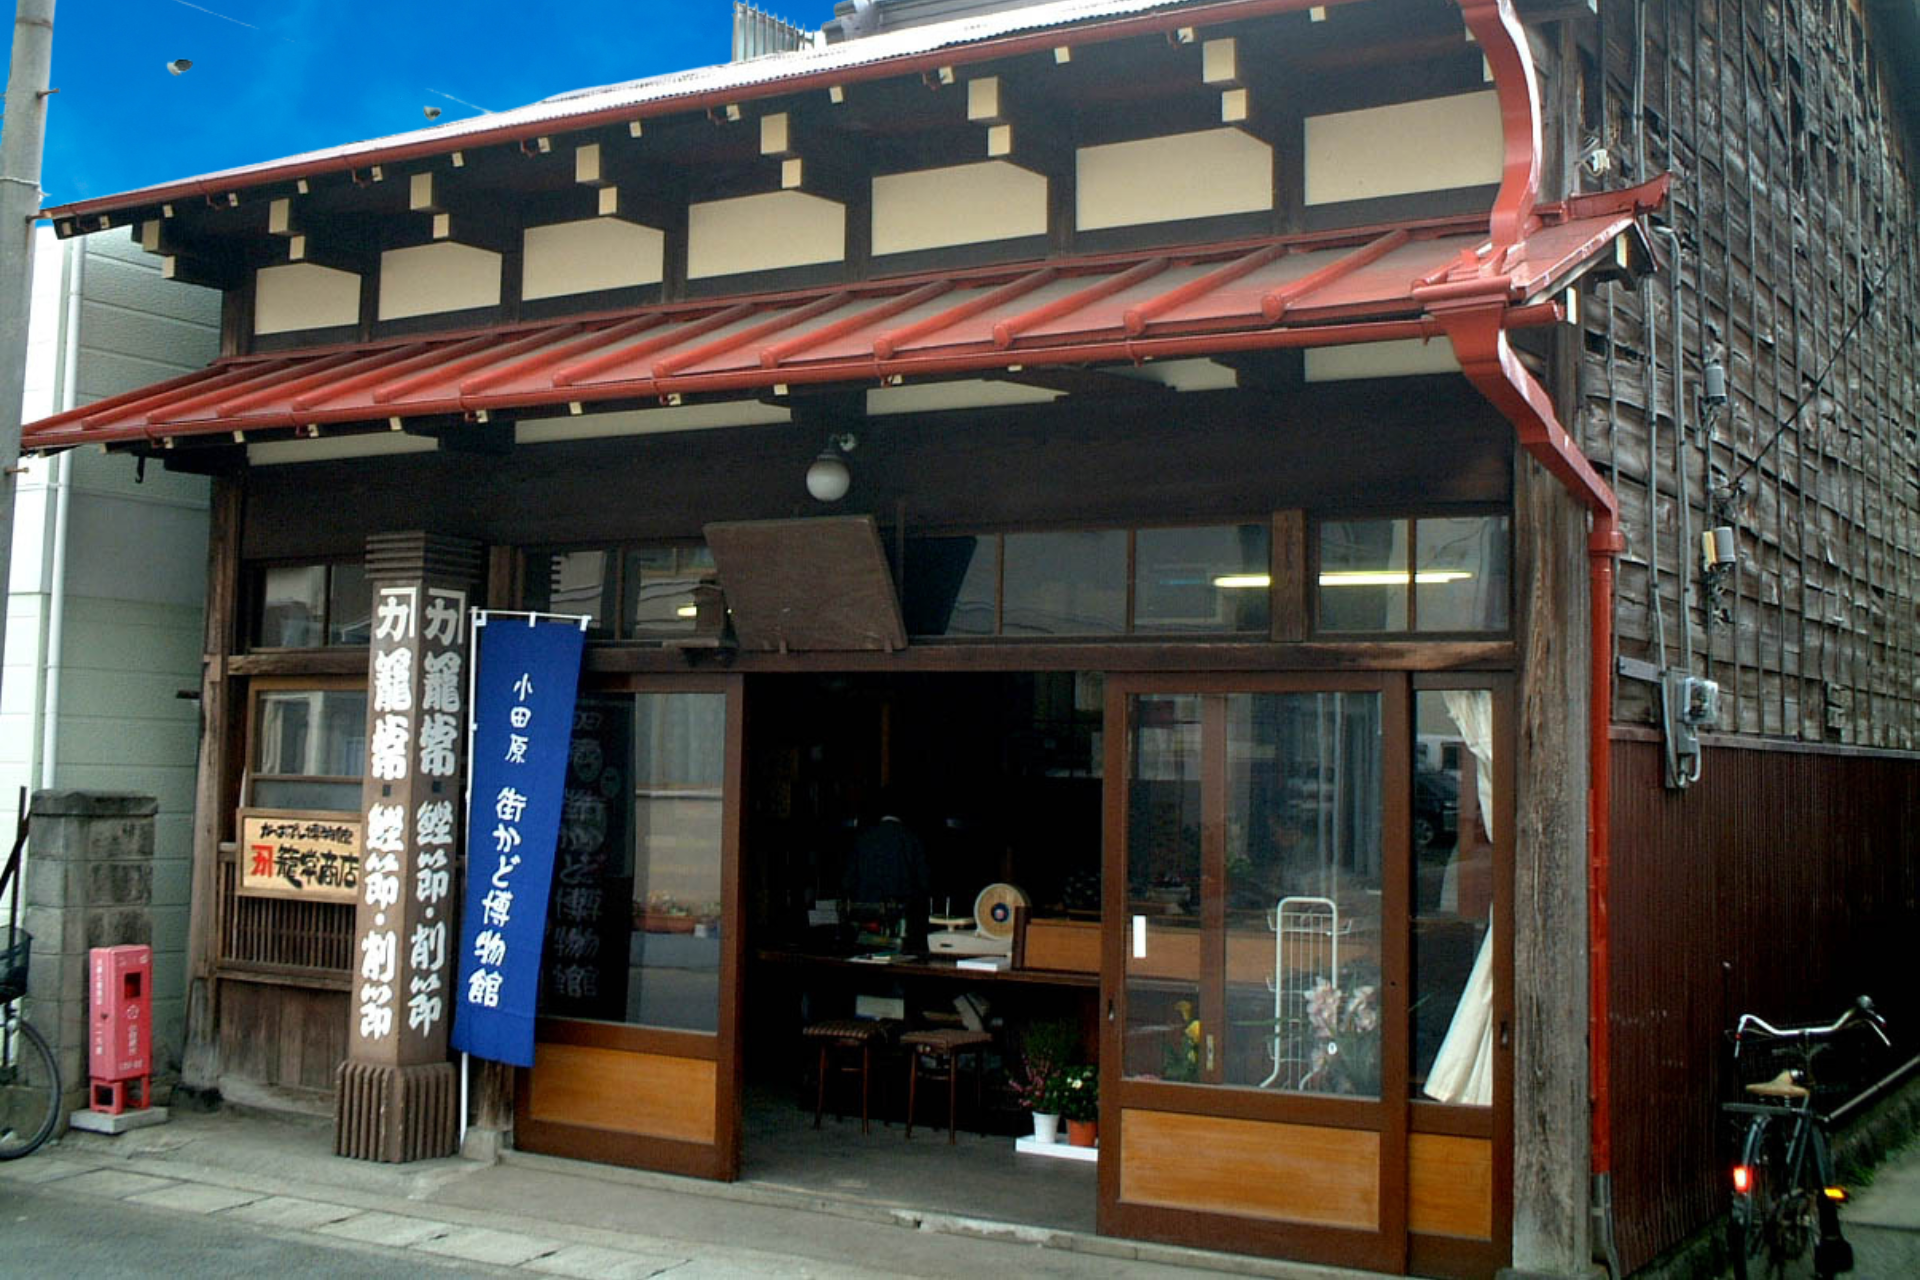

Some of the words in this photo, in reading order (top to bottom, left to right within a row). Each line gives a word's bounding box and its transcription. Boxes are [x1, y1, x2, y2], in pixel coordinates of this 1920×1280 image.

[505, 673, 533, 764] 小田原
[467, 786, 528, 1008] 街かど博物館
